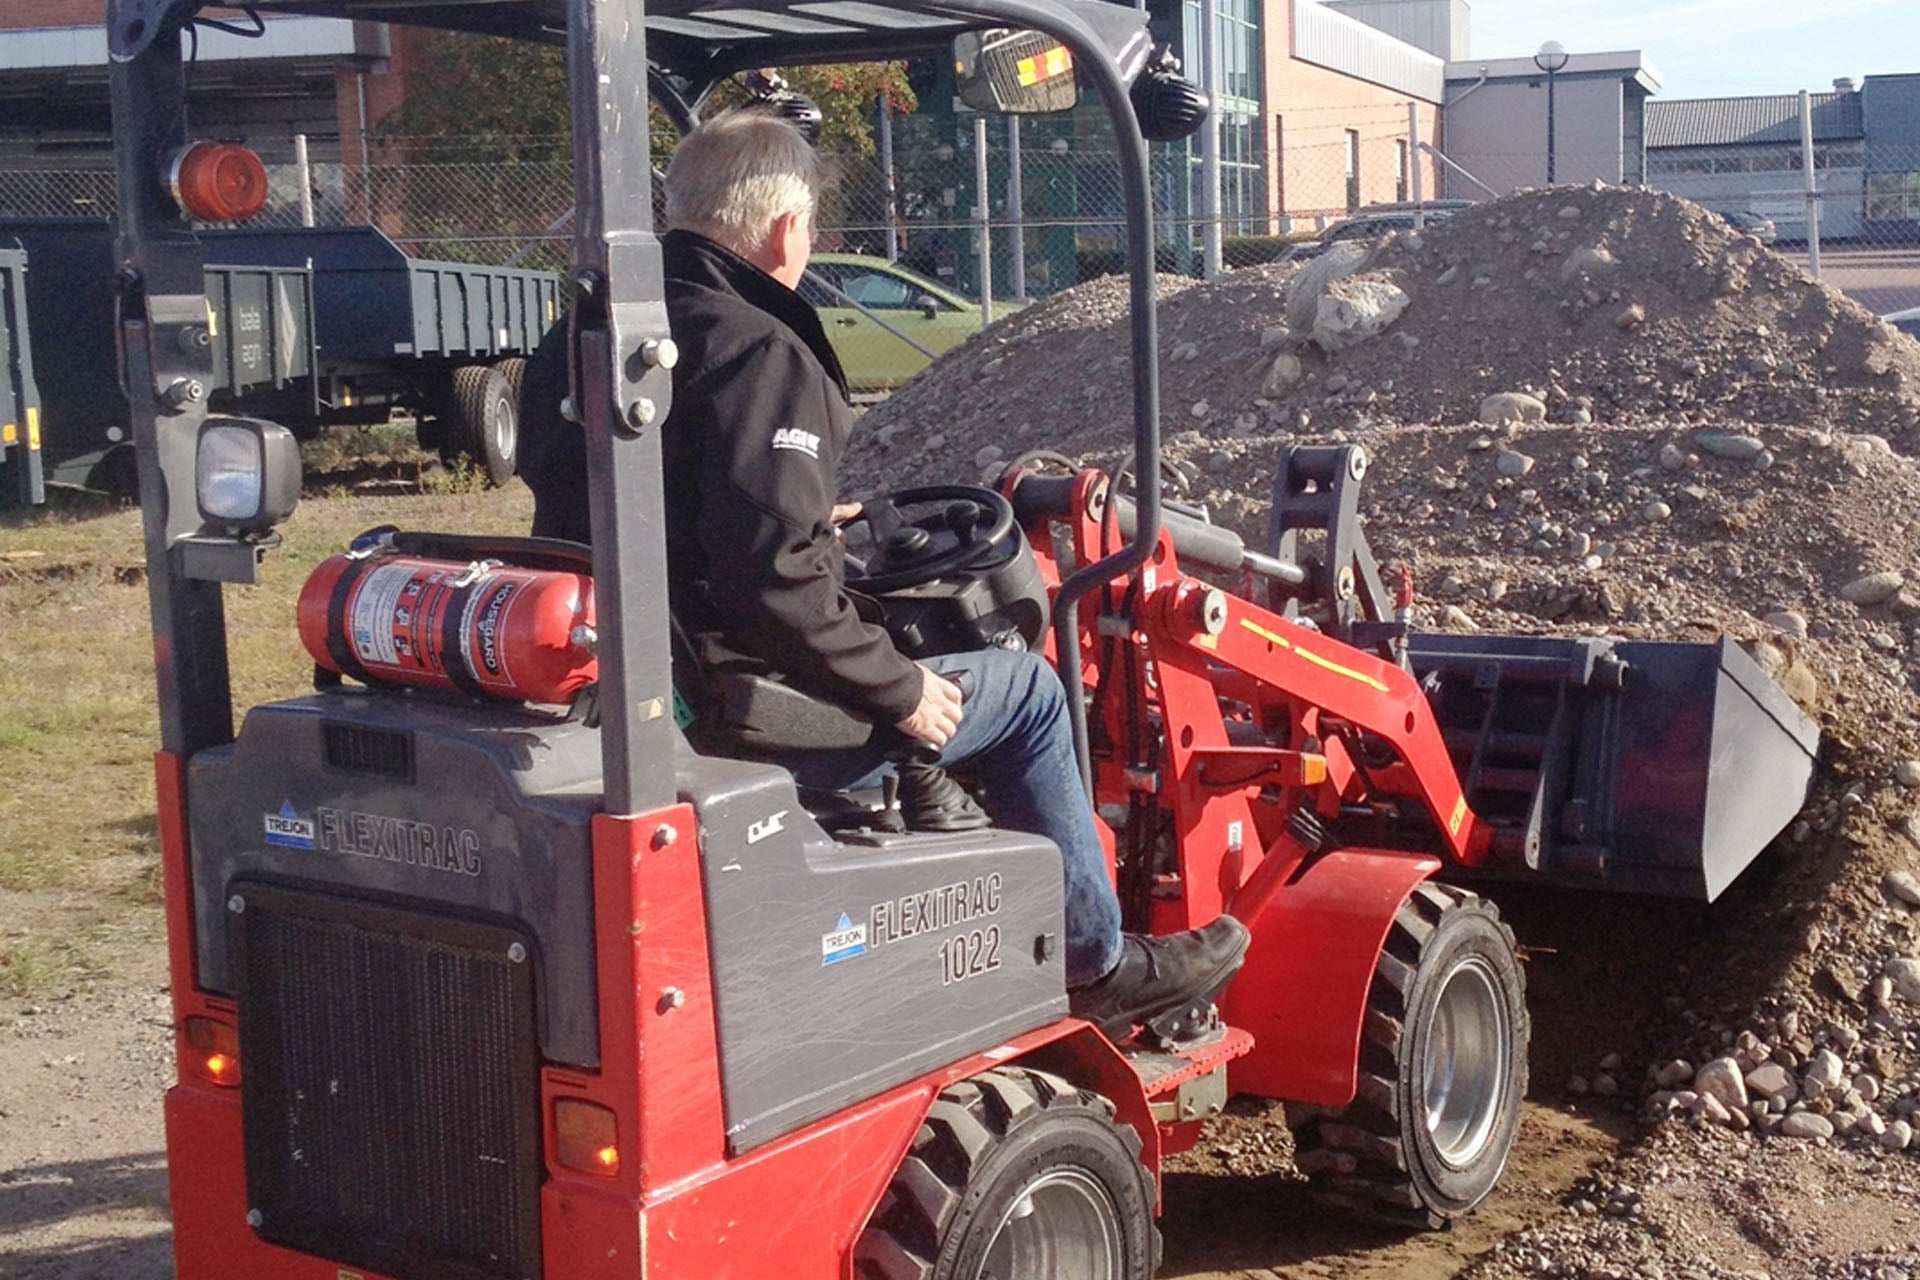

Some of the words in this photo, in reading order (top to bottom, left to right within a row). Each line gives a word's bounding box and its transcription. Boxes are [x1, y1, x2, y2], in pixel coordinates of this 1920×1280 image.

[482, 583, 515, 670] HOUSEGARD
[268, 817, 310, 837] TREJON
[317, 806, 482, 877] FLEXITRAC
[825, 929, 863, 951] TREJON
[870, 872, 1002, 948] FLEXITRAC
[938, 924, 1001, 986] 1022
